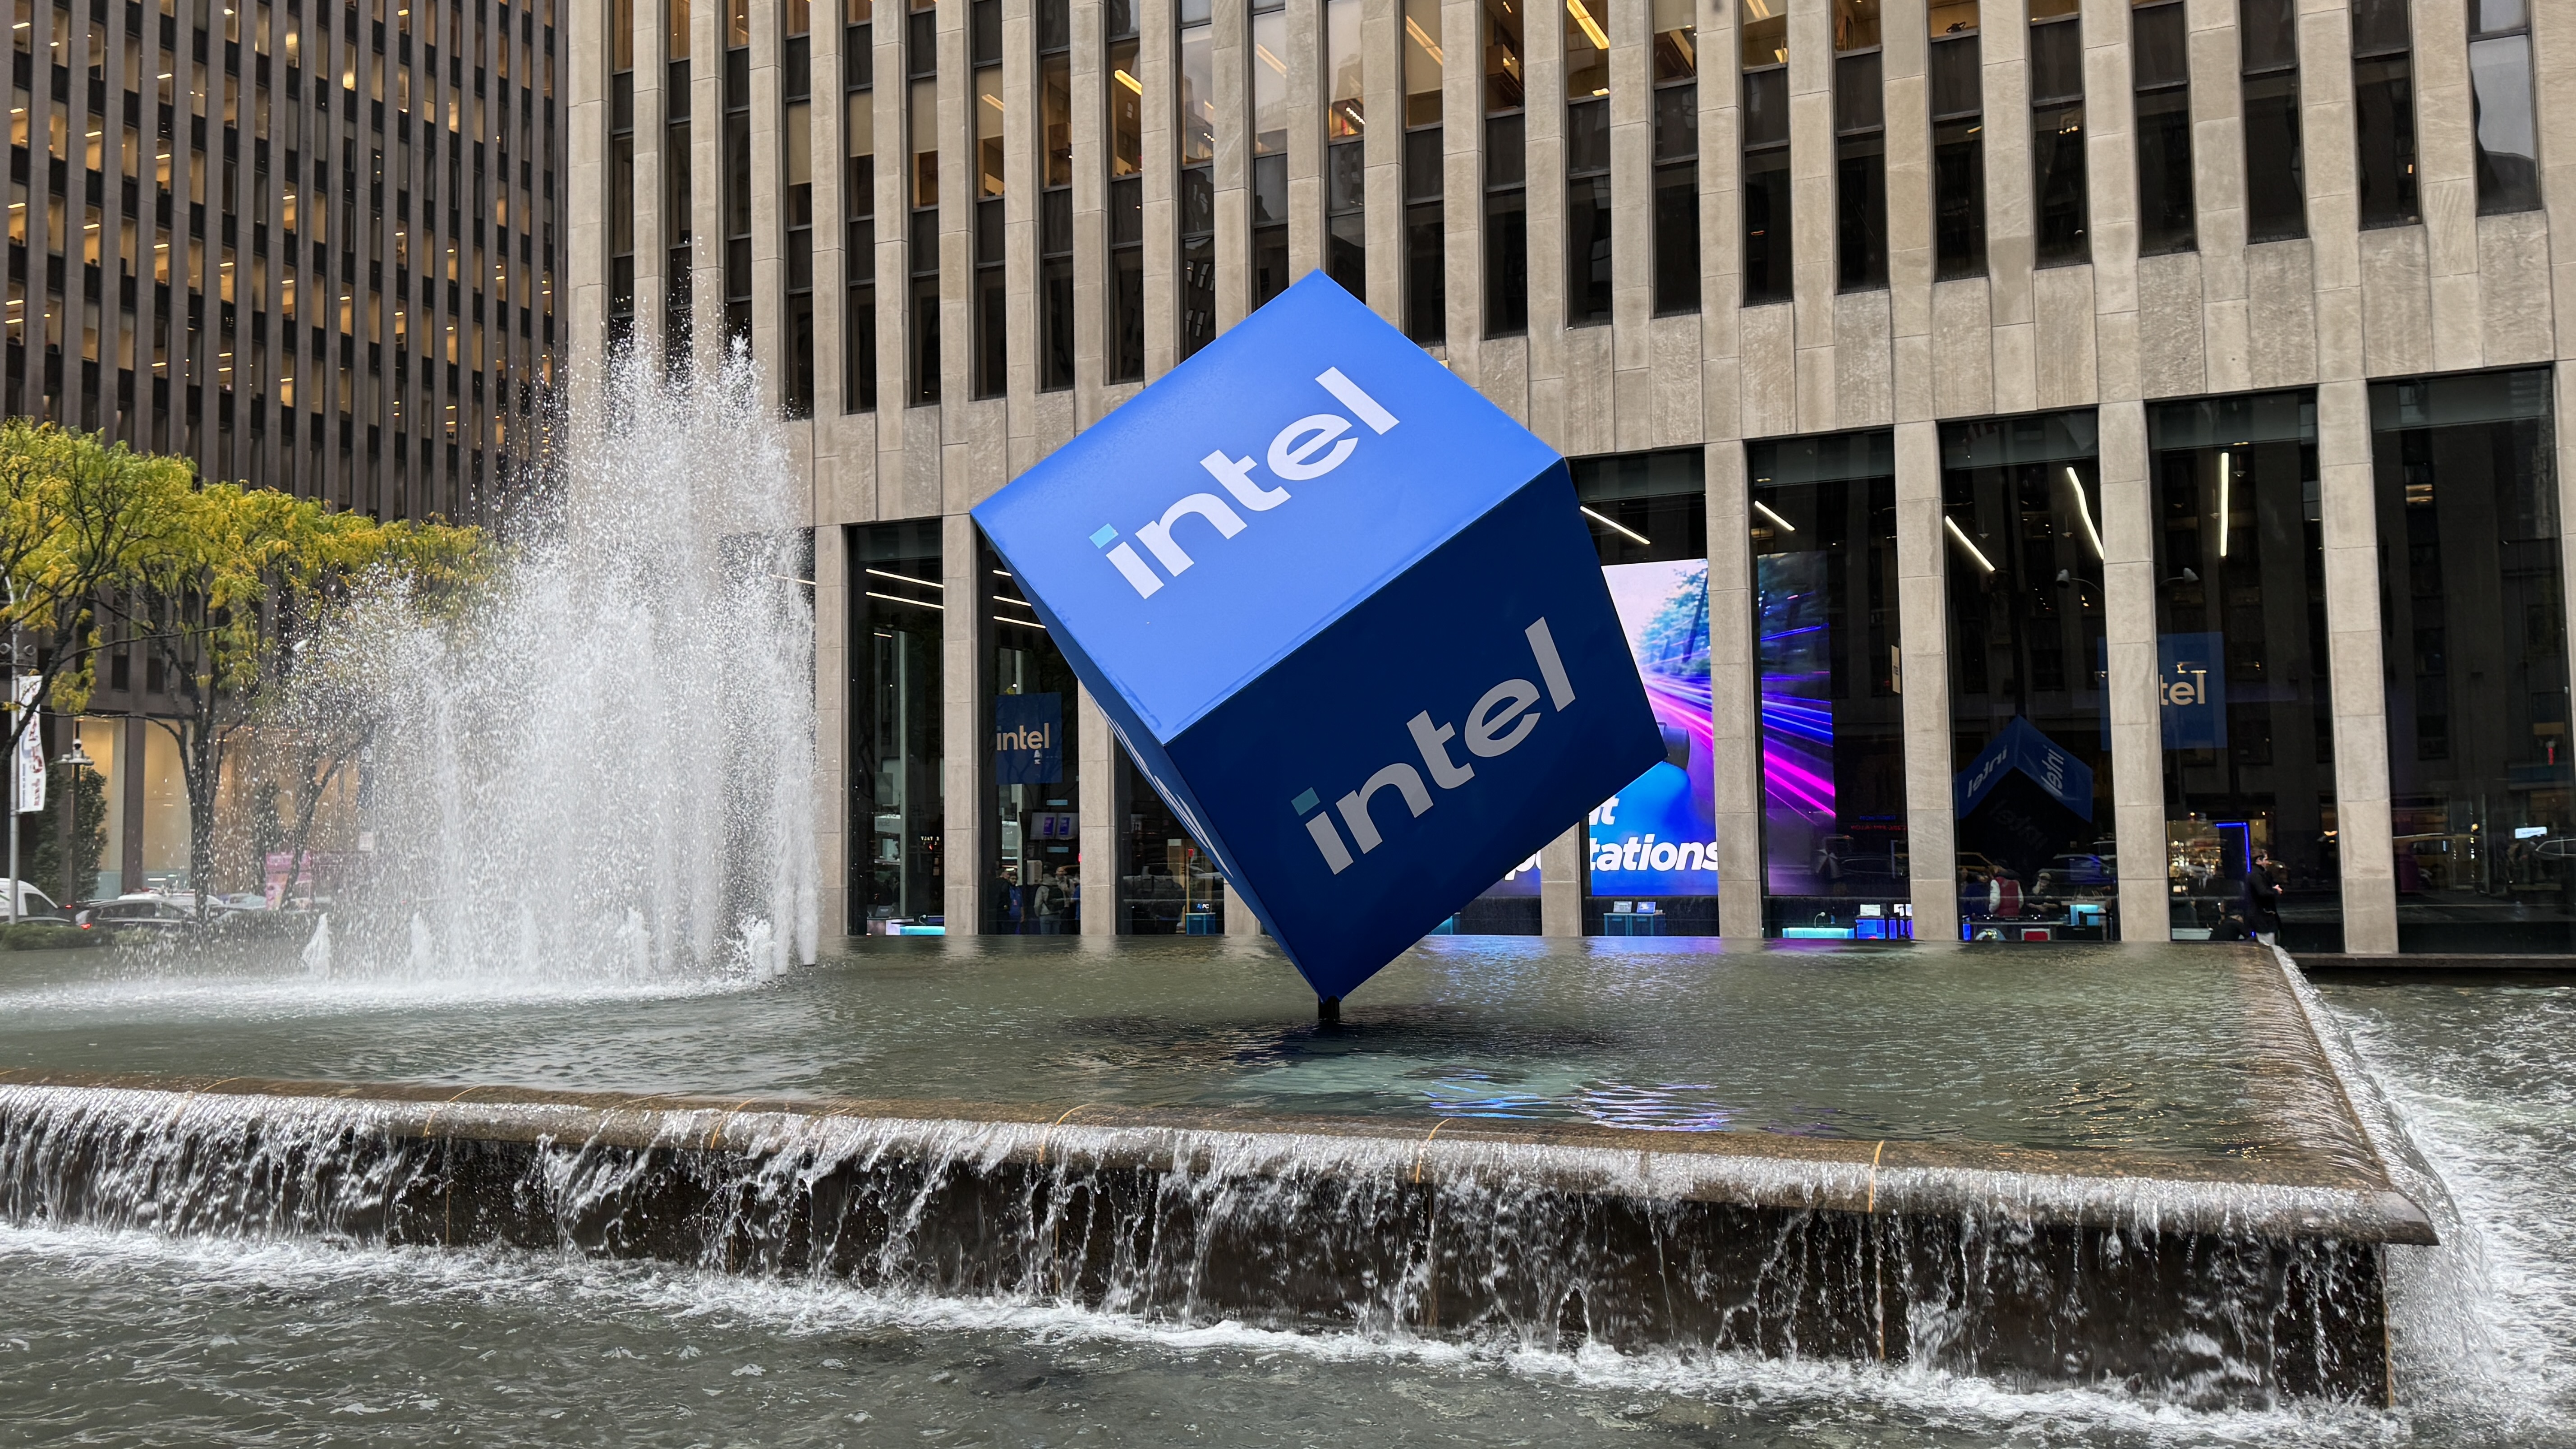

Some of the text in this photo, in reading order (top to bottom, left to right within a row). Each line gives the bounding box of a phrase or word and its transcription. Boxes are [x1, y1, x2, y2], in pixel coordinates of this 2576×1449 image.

[1089, 366, 1400, 599] intel
[997, 723, 1049, 750] intel
[1291, 616, 1576, 874] intel
[2160, 673, 2205, 705] tel
